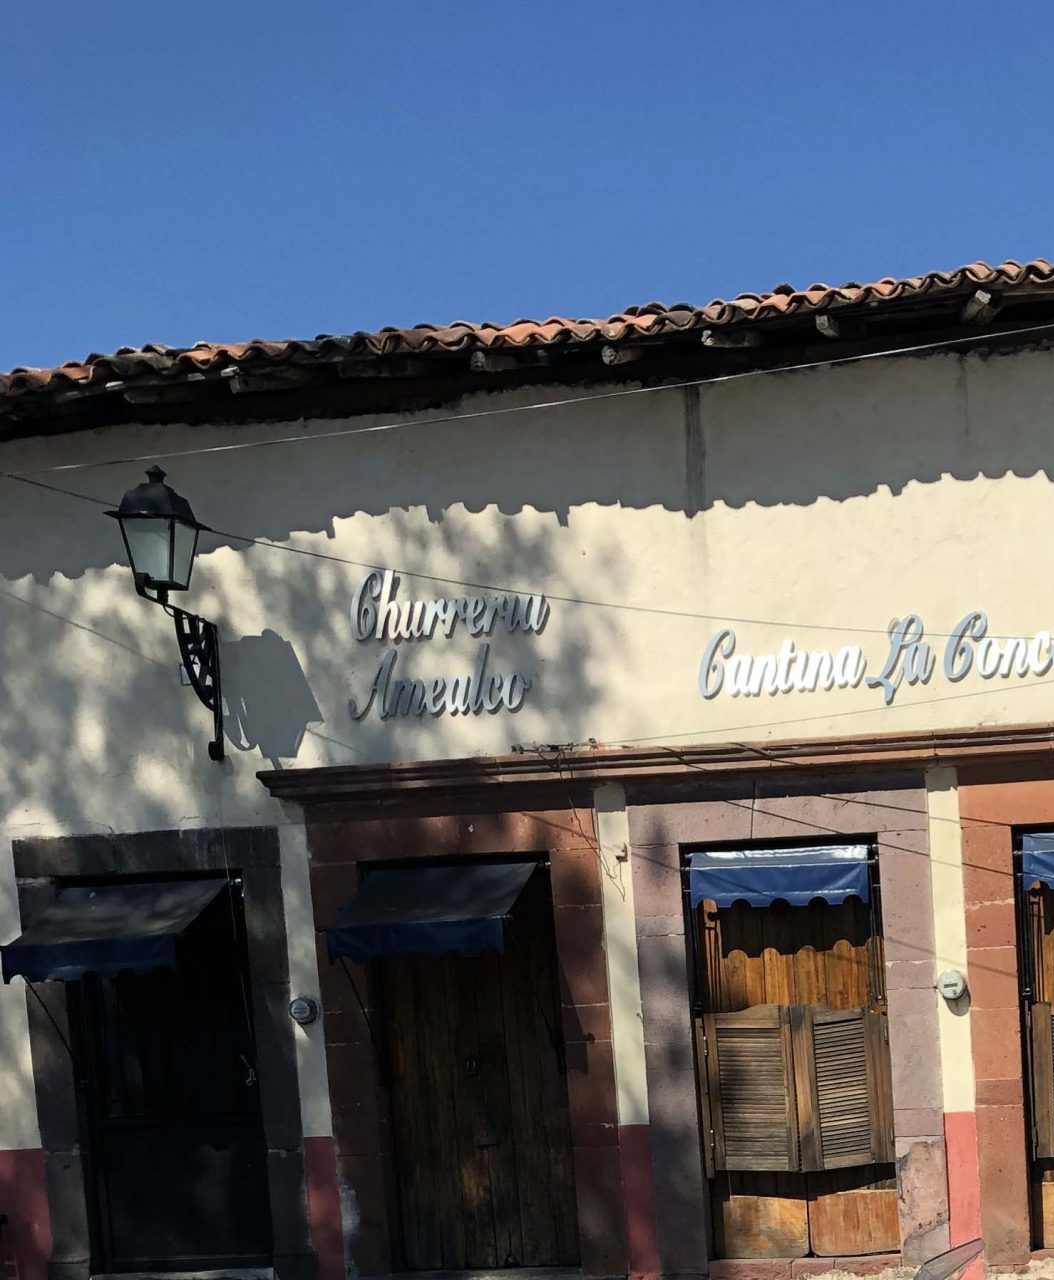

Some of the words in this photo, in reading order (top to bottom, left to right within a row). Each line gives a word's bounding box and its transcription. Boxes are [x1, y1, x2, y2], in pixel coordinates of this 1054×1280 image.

[349, 642, 533, 720] Amealco
[698, 627, 867, 700] Cantina
[866, 613, 935, 705] La
